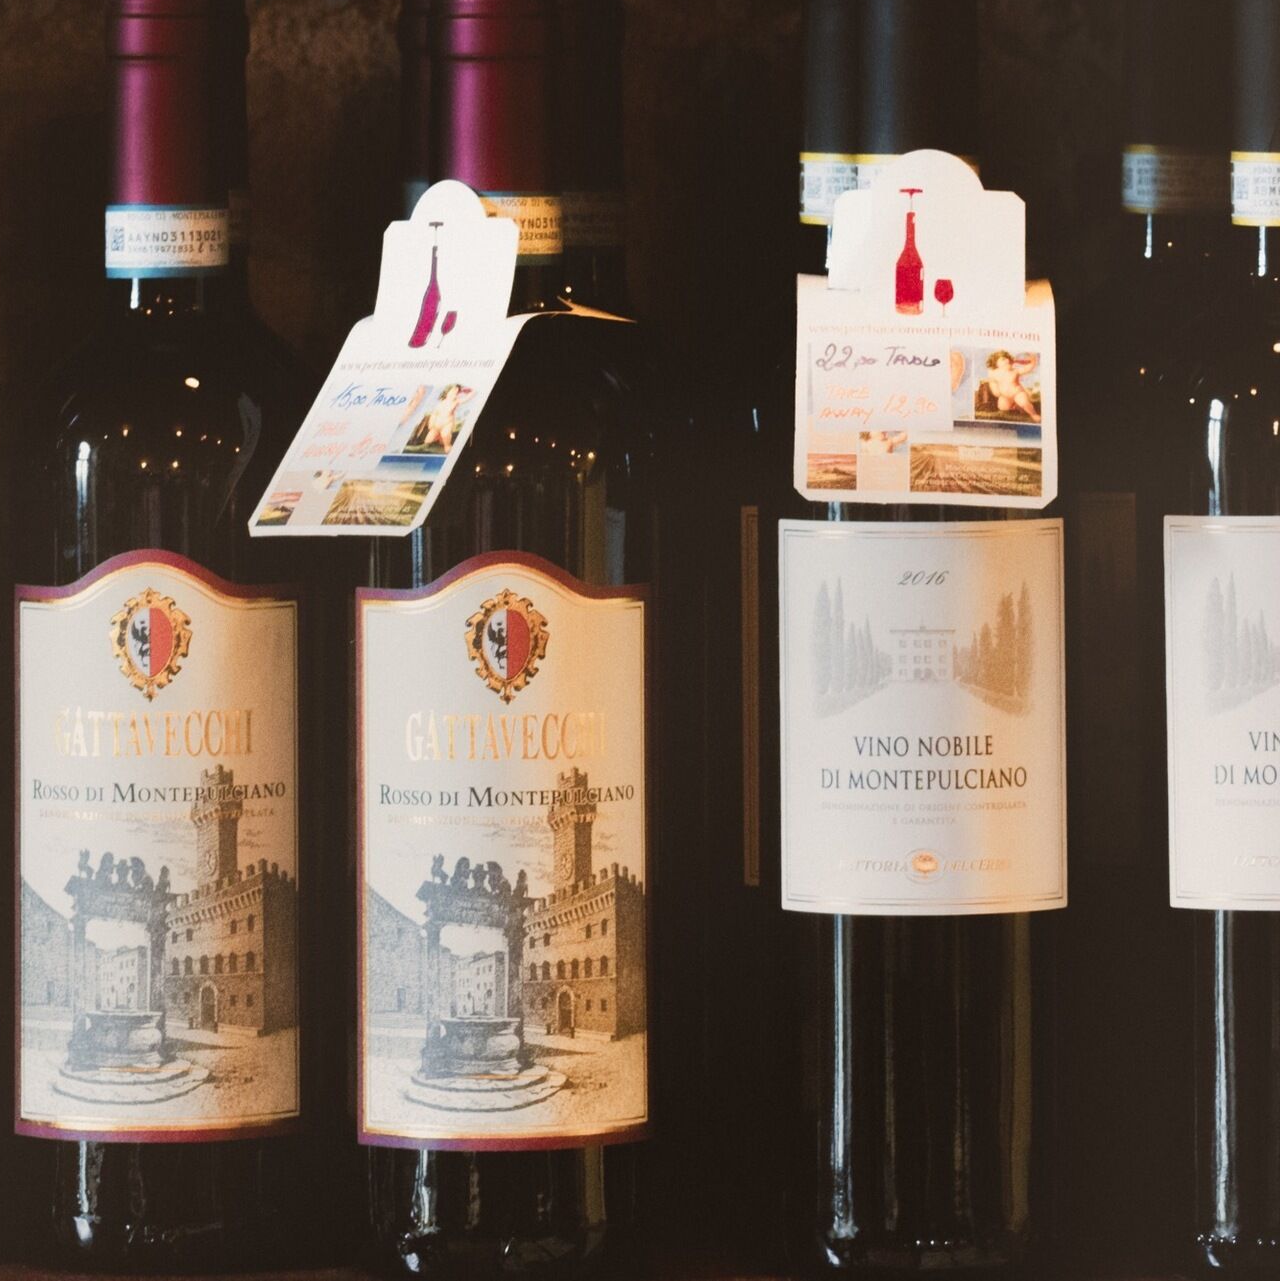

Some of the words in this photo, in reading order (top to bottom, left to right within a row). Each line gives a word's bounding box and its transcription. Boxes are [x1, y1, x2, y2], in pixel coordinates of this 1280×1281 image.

[897, 571, 949, 586] 2016
[854, 735, 909, 757] VINO
[918, 735, 994, 756] NOBILE
[820, 768, 841, 790] DI
[847, 766, 1028, 791] MONTEPULCIANO
[1214, 764, 1235, 786] DI
[32, 778, 80, 801] ROSSO
[85, 783, 104, 801] DI
[111, 780, 287, 804] MONTEPULCIANO
[379, 783, 433, 806] ROSSO
[438, 788, 459, 807] DI
[467, 783, 635, 808] MONTEPULCIANO
